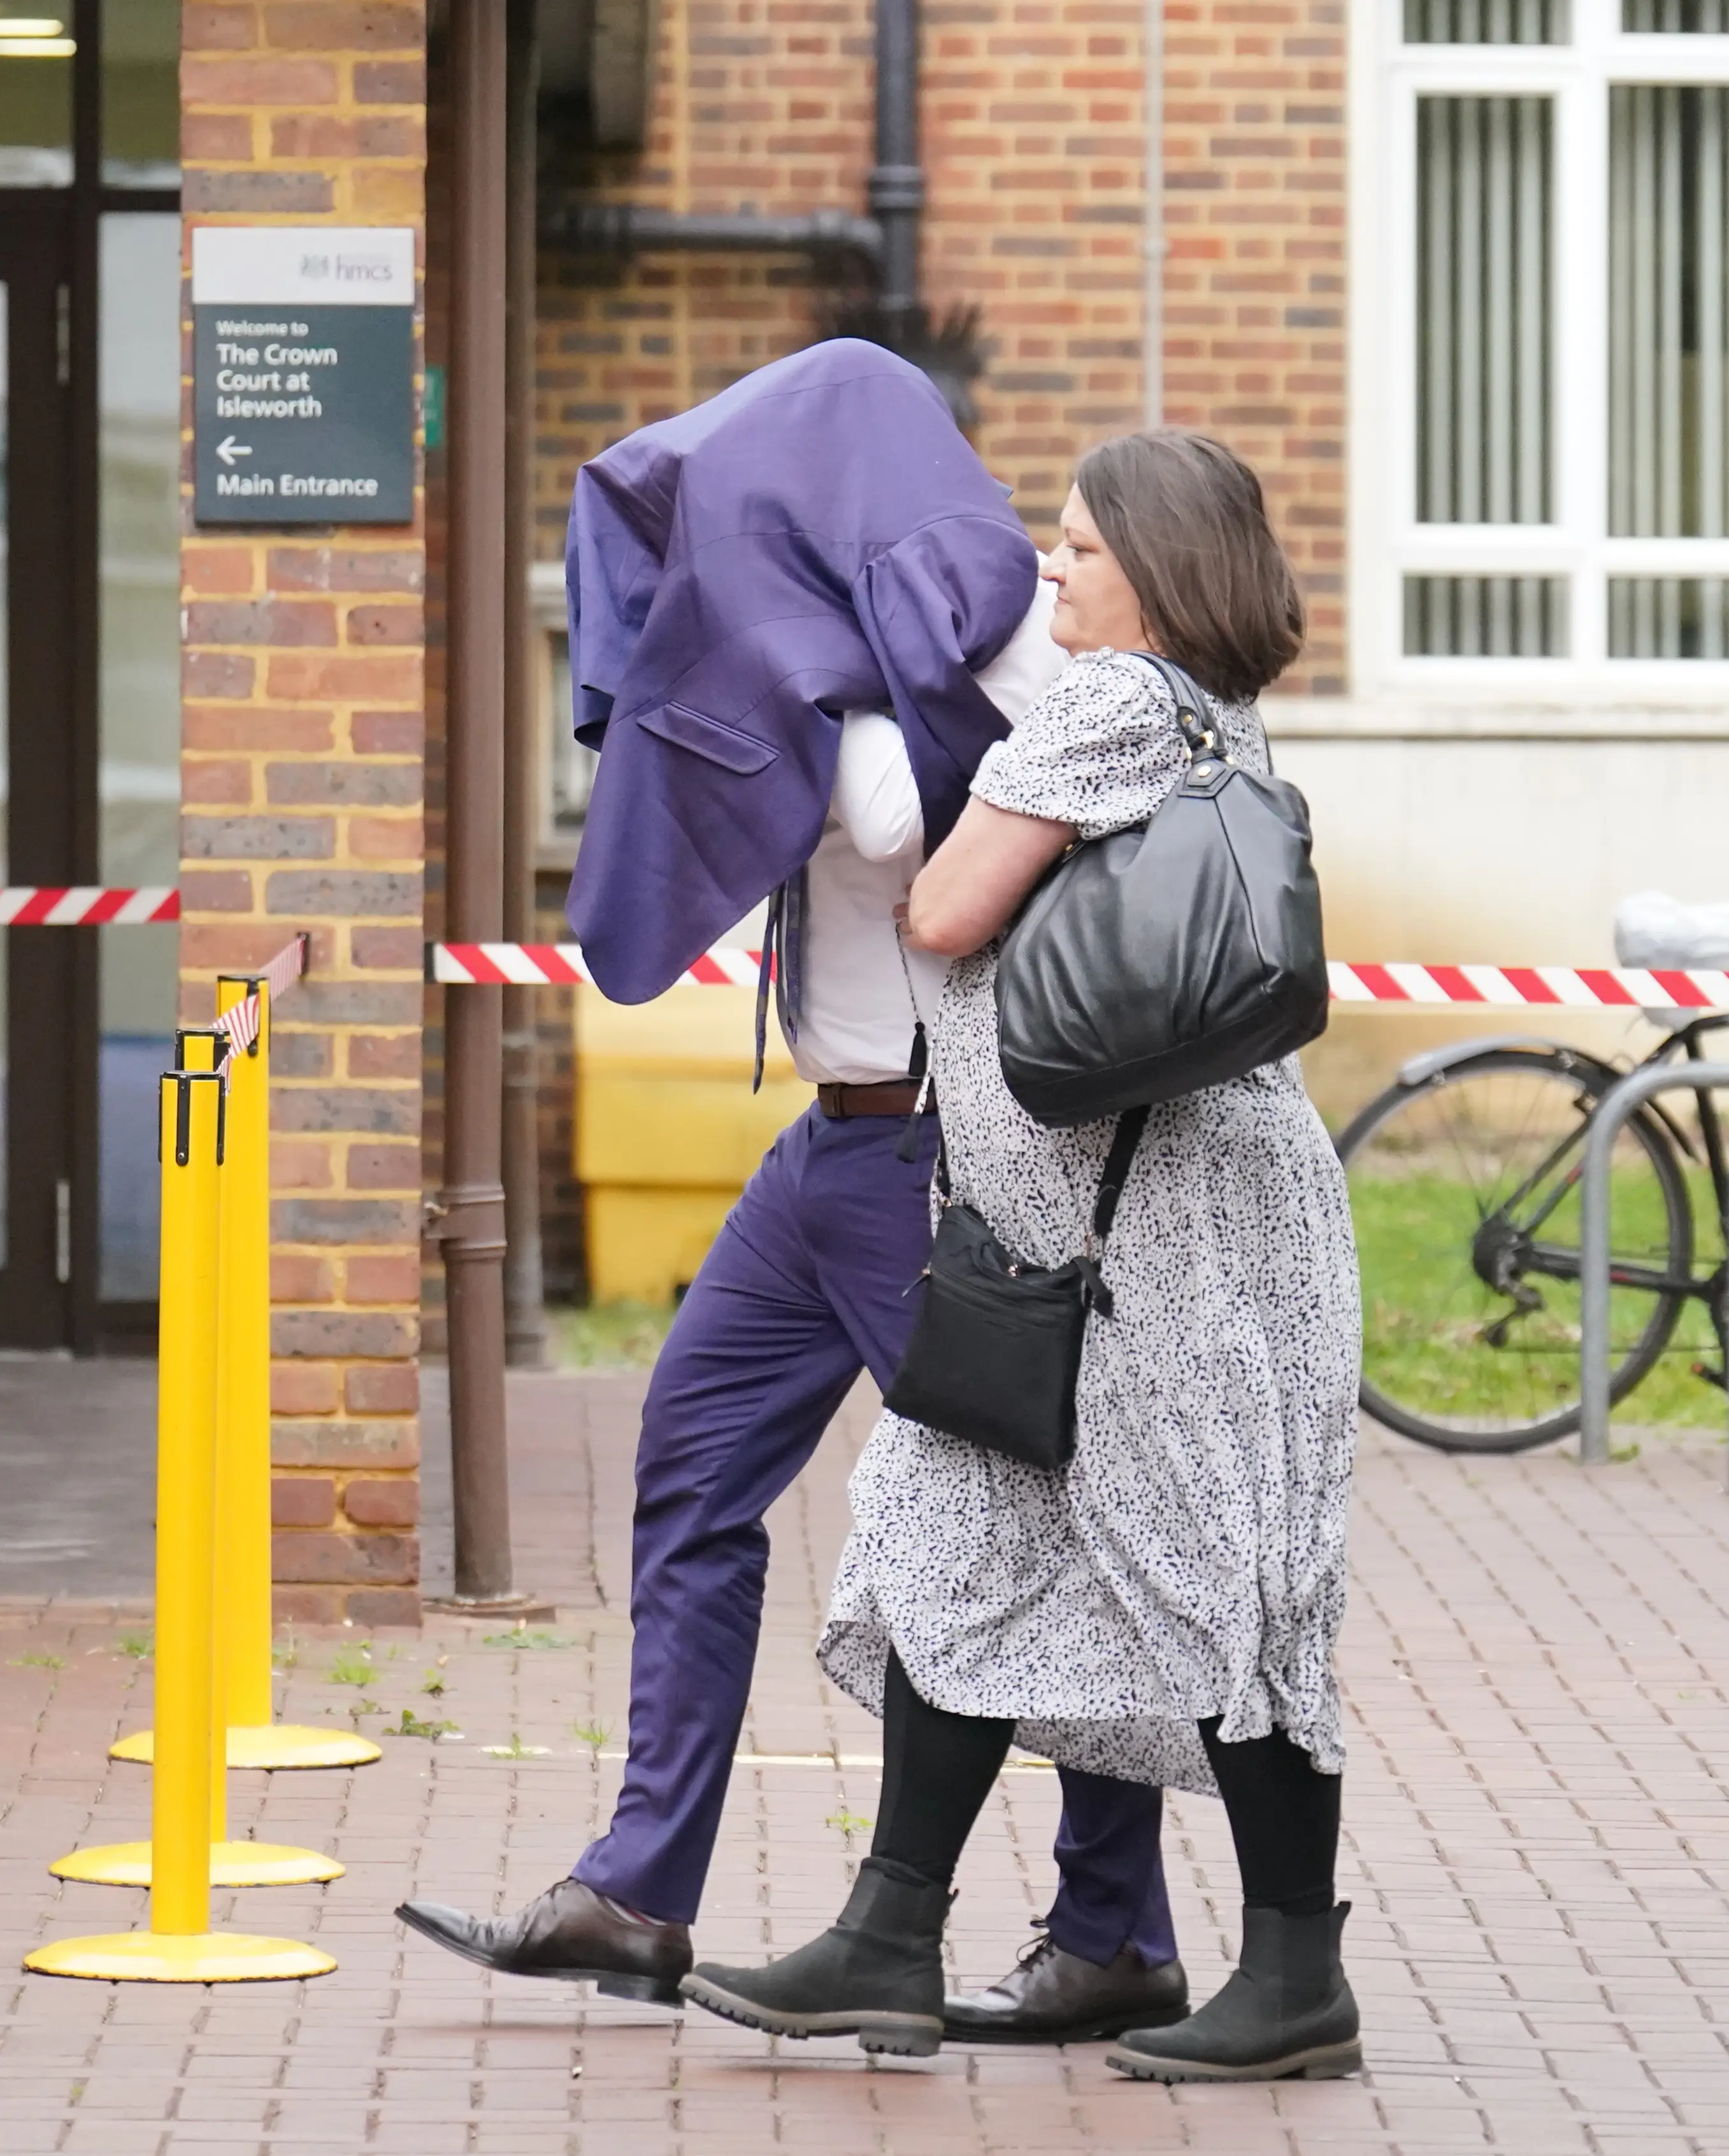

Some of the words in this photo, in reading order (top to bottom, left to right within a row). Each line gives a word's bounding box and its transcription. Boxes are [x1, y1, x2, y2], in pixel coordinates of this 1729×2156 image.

[334, 253, 393, 281] hmcs
[216, 320, 288, 336] Welcome
[291, 322, 309, 336] to
[216, 343, 259, 365] The
[264, 344, 338, 366] Crown
[216, 370, 281, 392] Court
[285, 372, 310, 392] at
[217, 396, 322, 418] Isleworth
[217, 475, 274, 496] Main
[280, 475, 378, 496] Entrance
